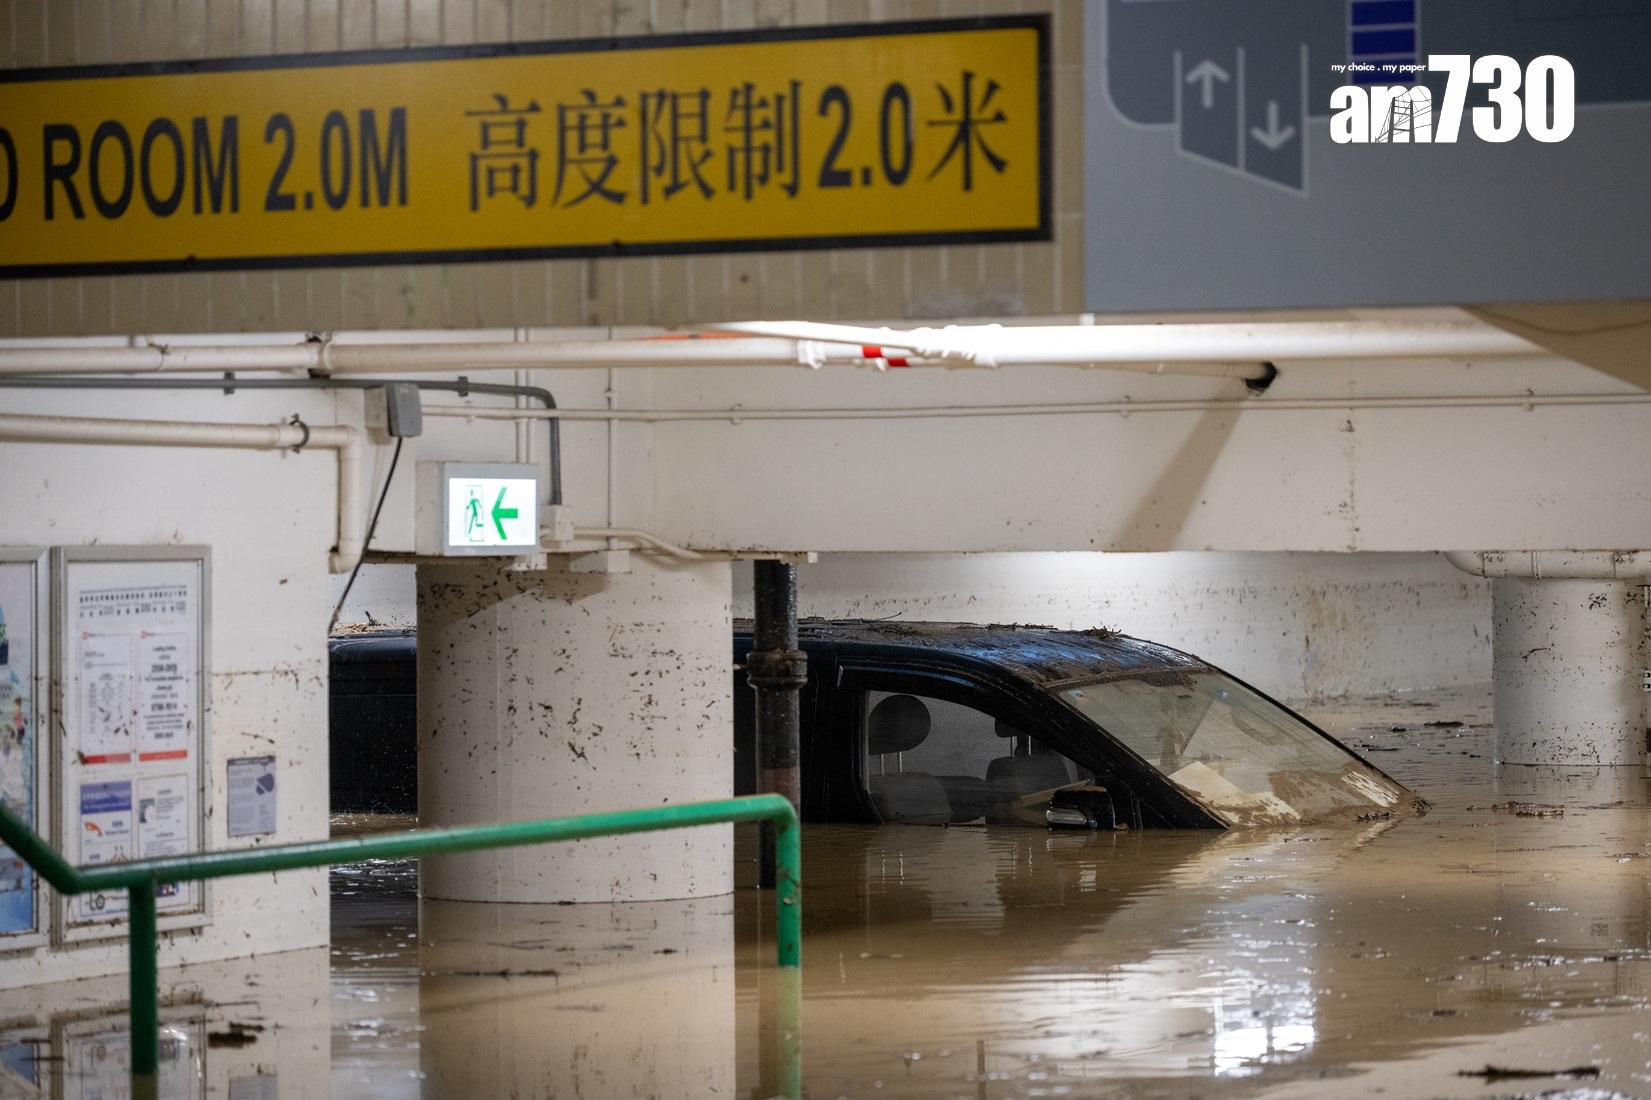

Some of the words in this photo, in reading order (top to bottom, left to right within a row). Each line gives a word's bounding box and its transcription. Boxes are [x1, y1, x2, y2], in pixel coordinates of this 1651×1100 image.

[43, 113, 240, 222] ROOM
[265, 106, 408, 213] 2.0M
[464, 71, 1009, 213] 高度限制2.0米
